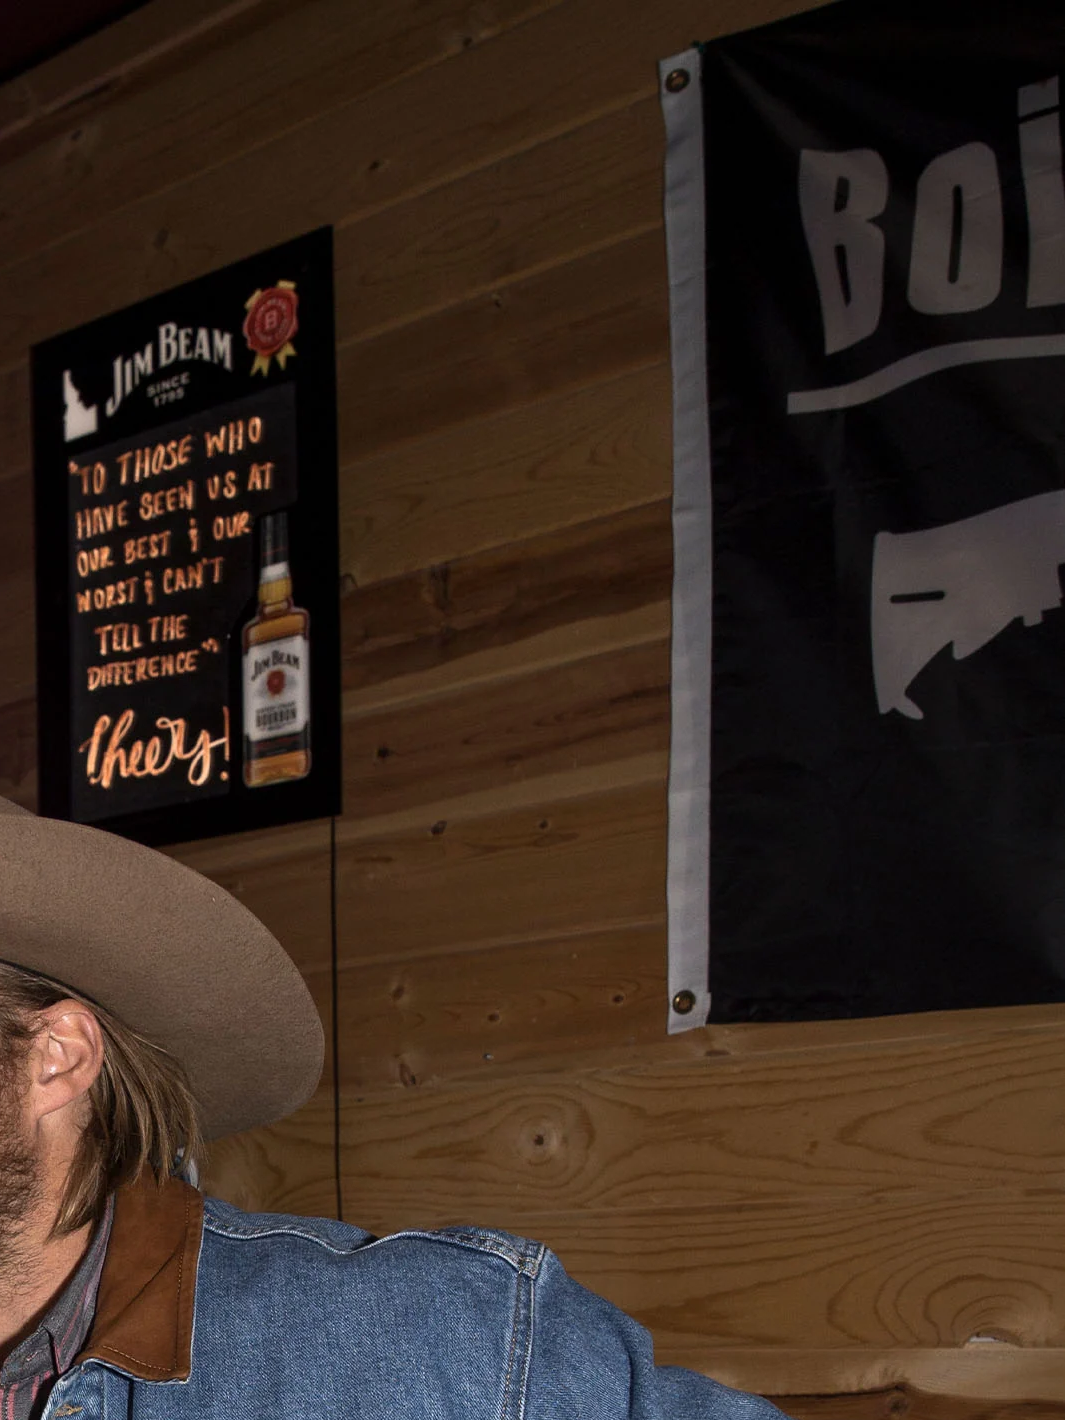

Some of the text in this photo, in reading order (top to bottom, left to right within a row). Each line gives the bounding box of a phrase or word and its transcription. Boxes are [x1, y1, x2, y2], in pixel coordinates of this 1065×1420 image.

[105, 322, 233, 417] JIM BEAM
[146, 371, 190, 398] SINCE
[116, 434, 193, 485] THOSE
[204, 416, 263, 458] WHO
[75, 462, 275, 540] HAVE SEEN US AT
[76, 545, 114, 577] OUR
[124, 530, 172, 565] BEST
[212, 511, 253, 541] OUR
[75, 576, 139, 613] WORST
[163, 556, 225, 595] CAN'T
[95, 614, 190, 656] TELL THE
[79, 705, 230, 789] Cheers!
